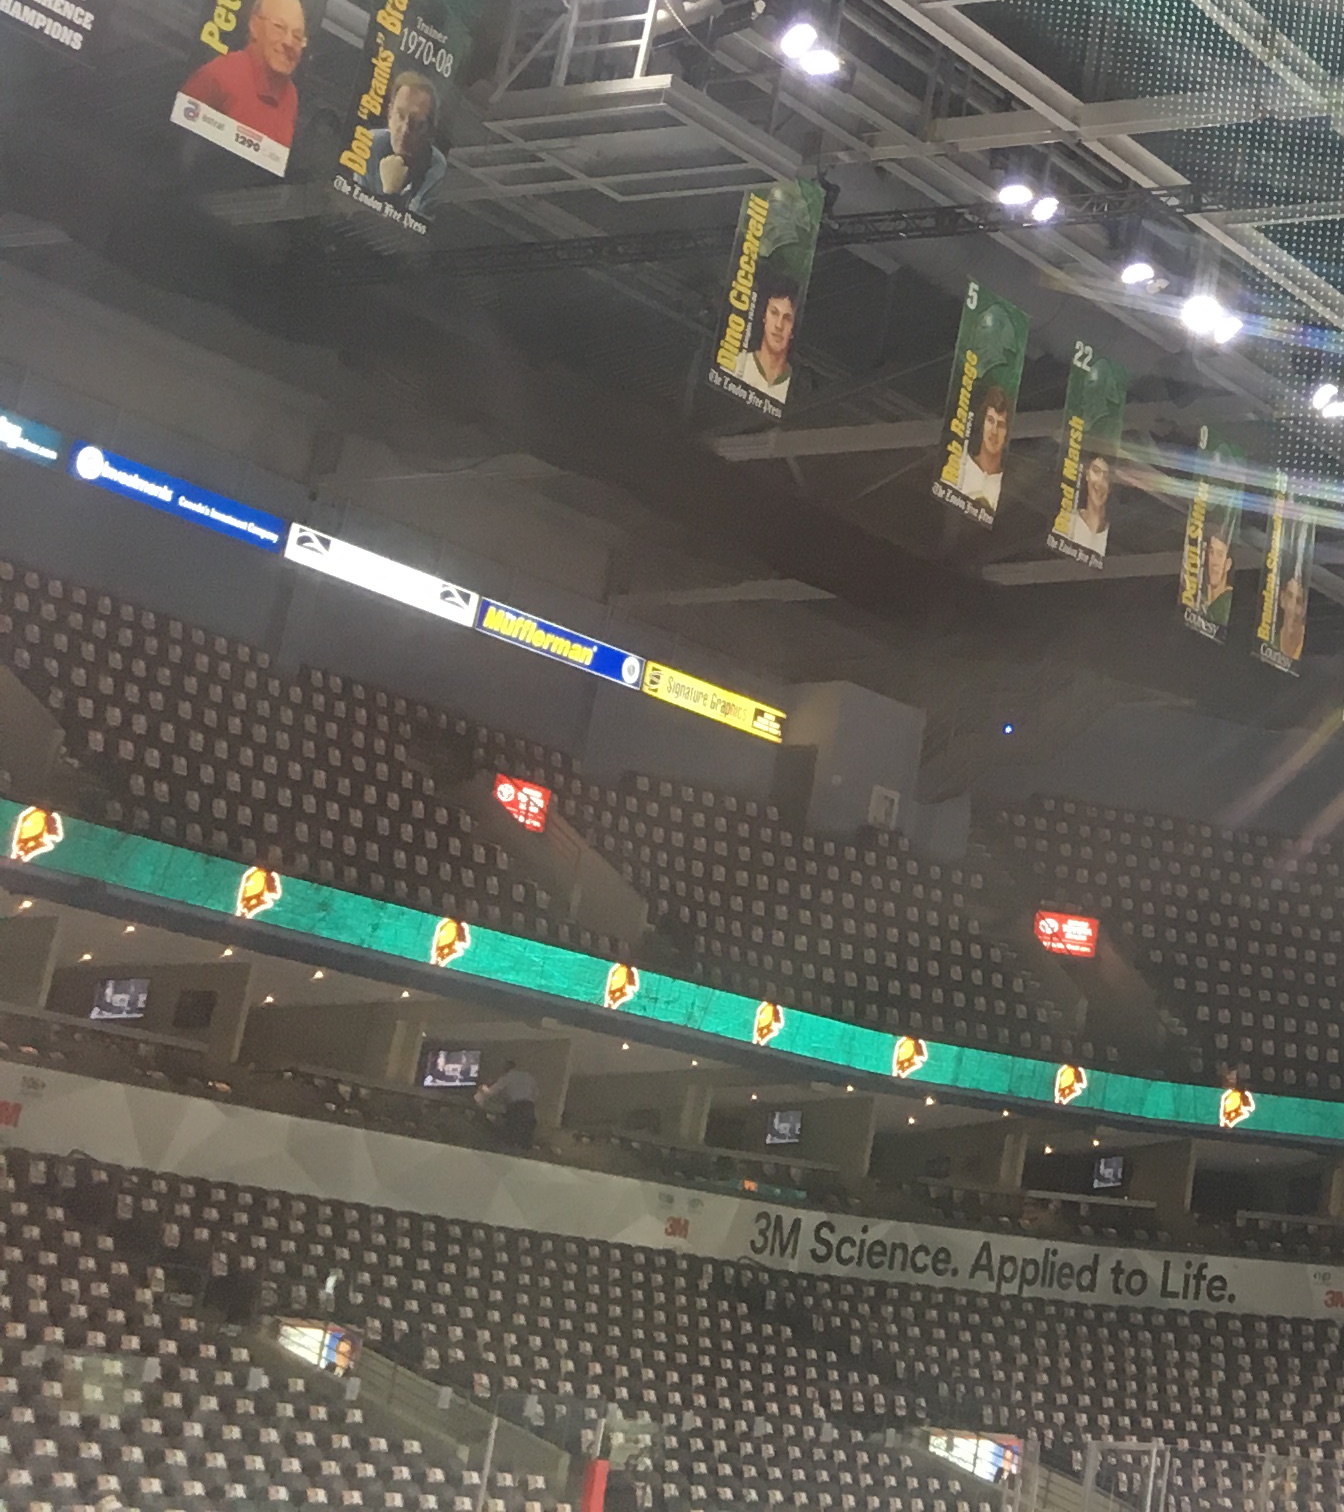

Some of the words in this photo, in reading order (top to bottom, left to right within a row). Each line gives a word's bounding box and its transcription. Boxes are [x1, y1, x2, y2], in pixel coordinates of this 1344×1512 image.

[399, 27, 454, 78] 1970-08
[415, 16, 449, 44] Trainer
[234, 132, 261, 152] 1290
[340, 125, 374, 177] Don
[402, 210, 427, 235] Press
[729, 192, 771, 312] Ciccarelli
[966, 281, 980, 310] 5
[716, 313, 747, 372] Dino
[1072, 339, 1094, 372] 22
[950, 349, 979, 438] Ramage
[1063, 415, 1086, 475] Marsh
[666, 675, 708, 707] Signature
[709, 692, 748, 722] Graphics
[664, 1216, 690, 1239] 3M
[750, 1211, 802, 1259] 3M
[810, 1221, 958, 1277] Science.
[969, 1240, 1100, 1294] Applied
[1111, 1259, 1149, 1296] to
[1159, 1259, 1237, 1305] Life.
